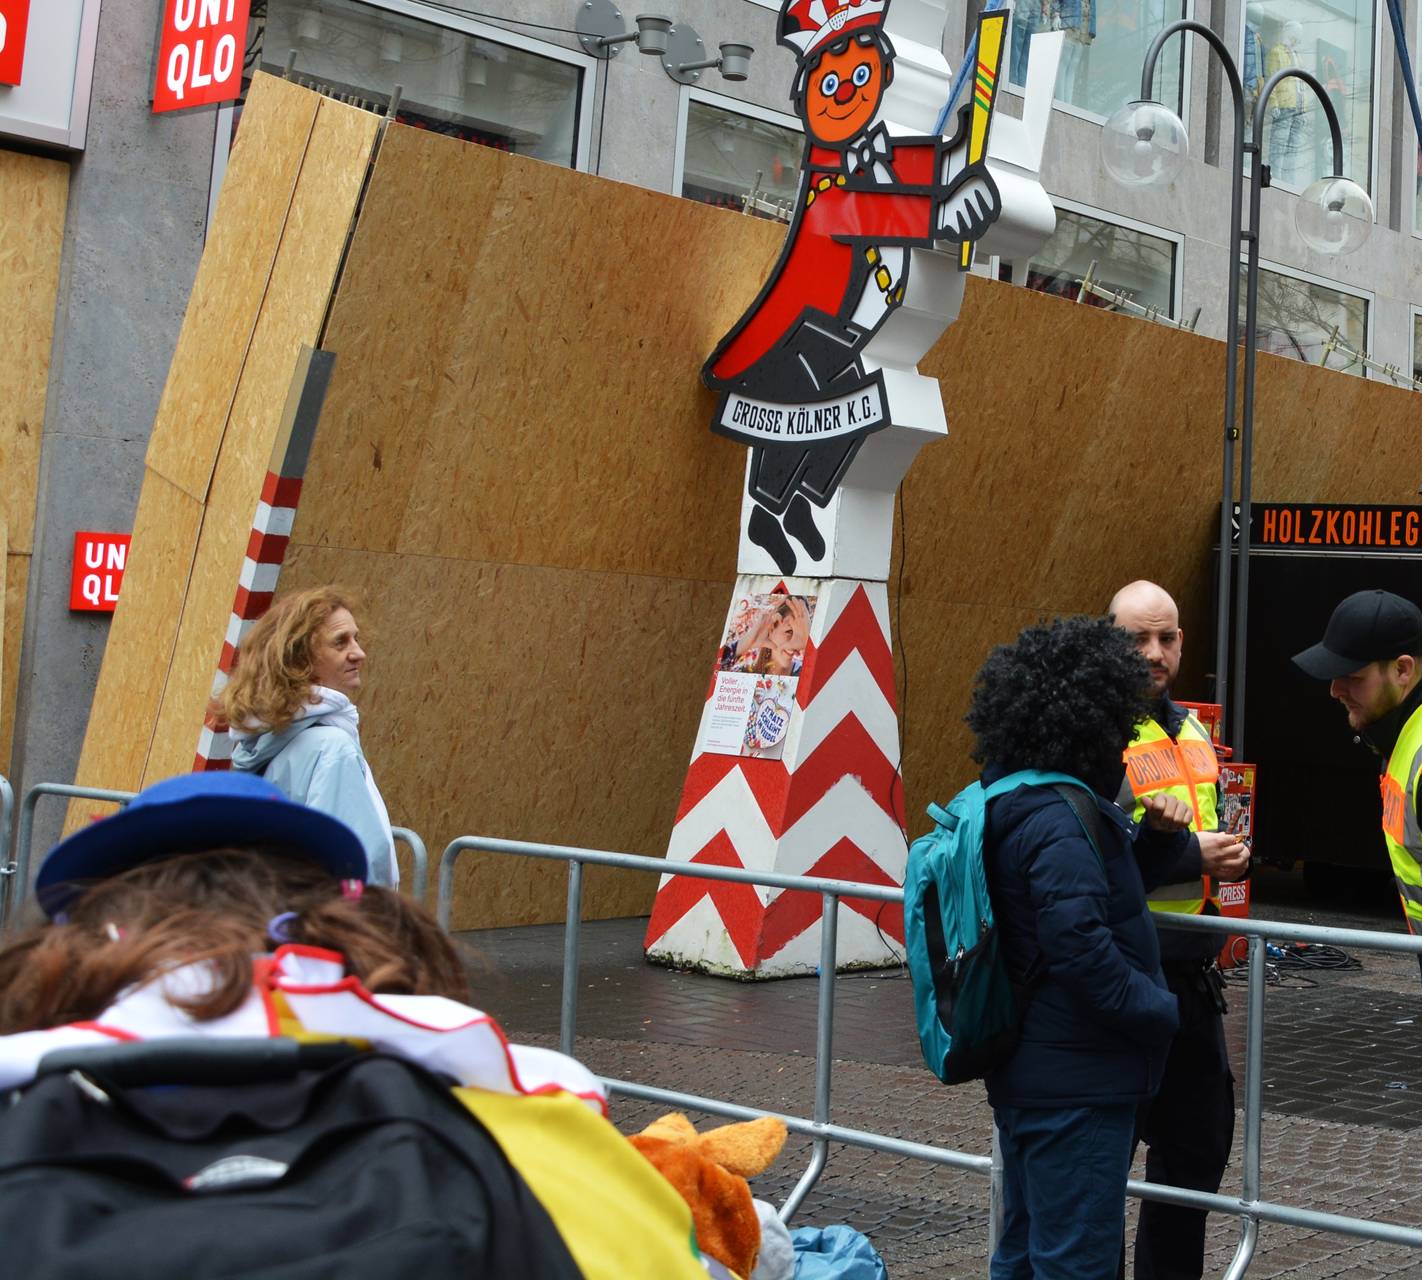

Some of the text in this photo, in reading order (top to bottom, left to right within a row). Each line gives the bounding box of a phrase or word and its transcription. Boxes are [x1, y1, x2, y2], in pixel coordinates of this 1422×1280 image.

[167, 34, 236, 99] QLO
[732, 395, 877, 435] GROSSE KÖLNER K.G.
[85, 542, 126, 570] UN
[83, 574, 119, 605] QL
[1218, 884, 1246, 902] XPRESS
